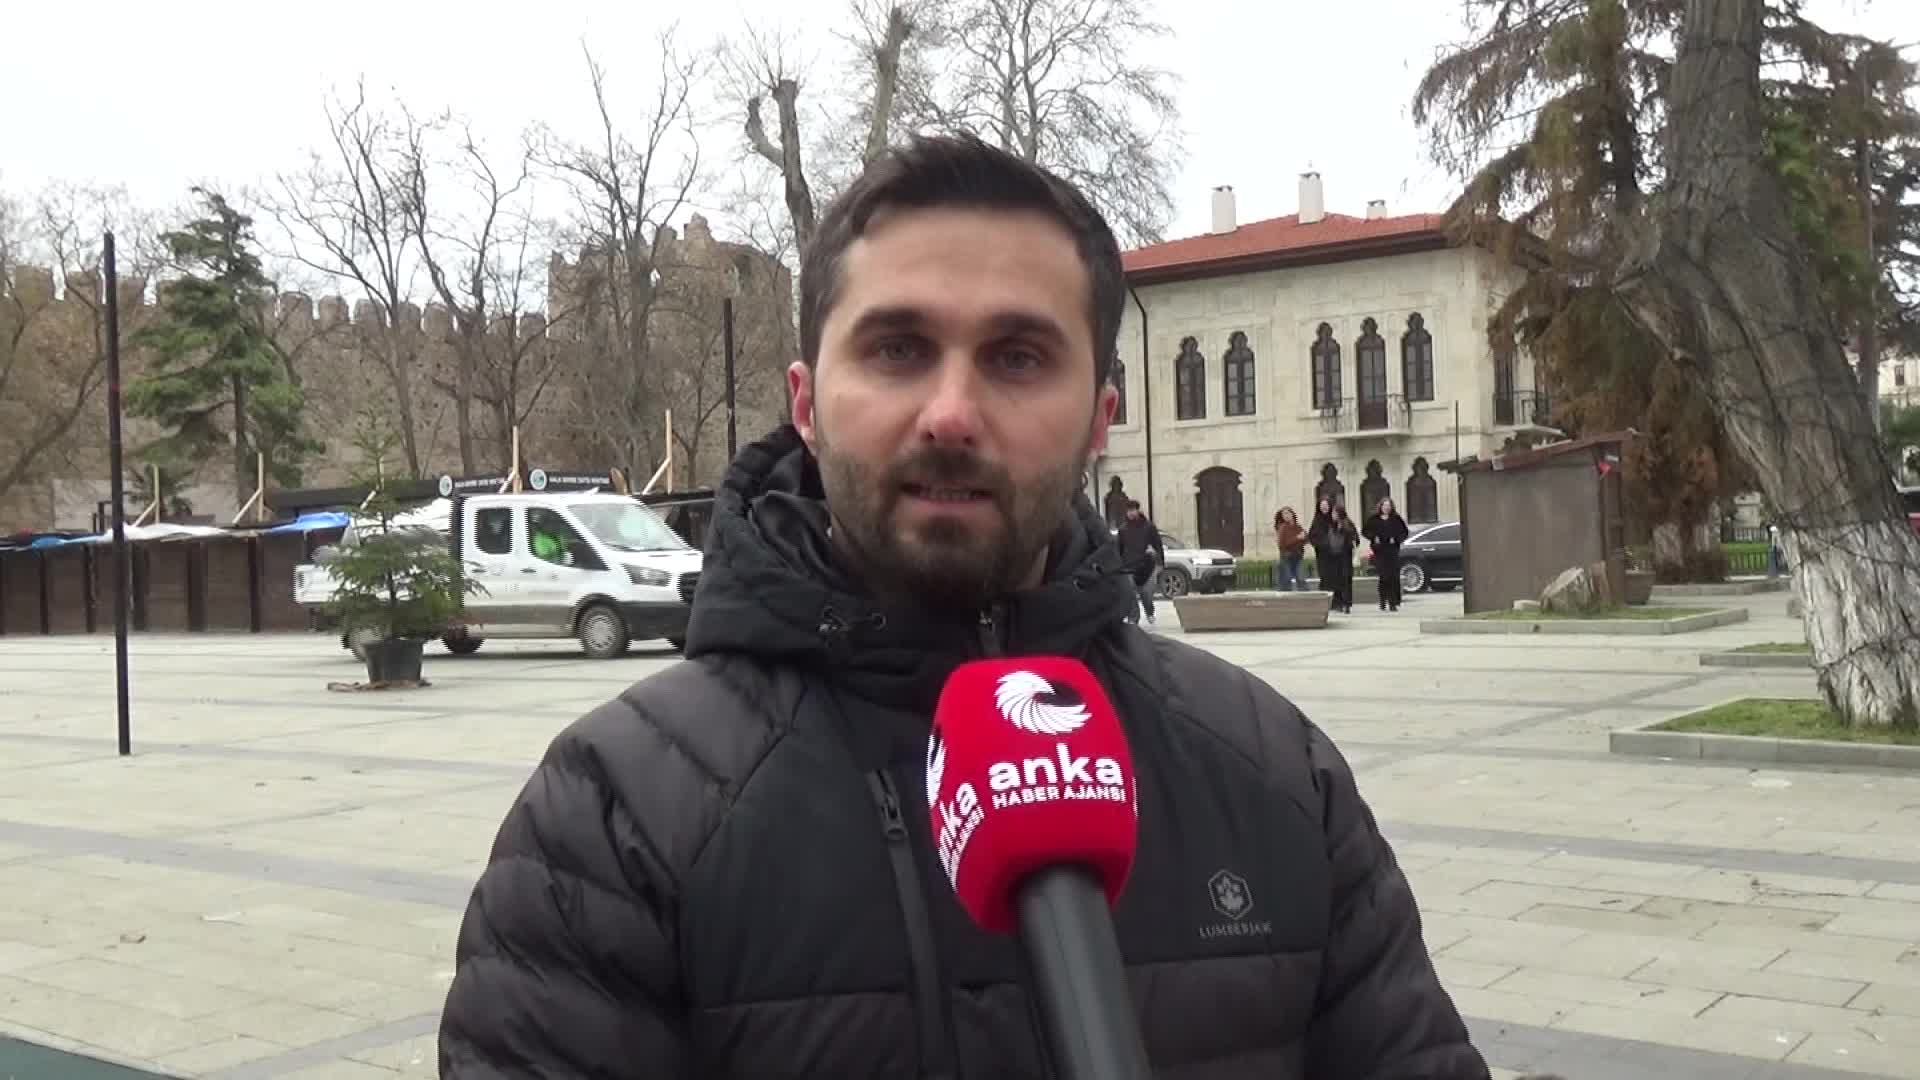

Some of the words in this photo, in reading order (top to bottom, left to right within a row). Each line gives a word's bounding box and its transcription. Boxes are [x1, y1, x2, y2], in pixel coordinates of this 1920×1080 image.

[988, 742, 1124, 791] anka
[991, 786, 1060, 810] HABER
[1063, 784, 1127, 803] AJANSI
